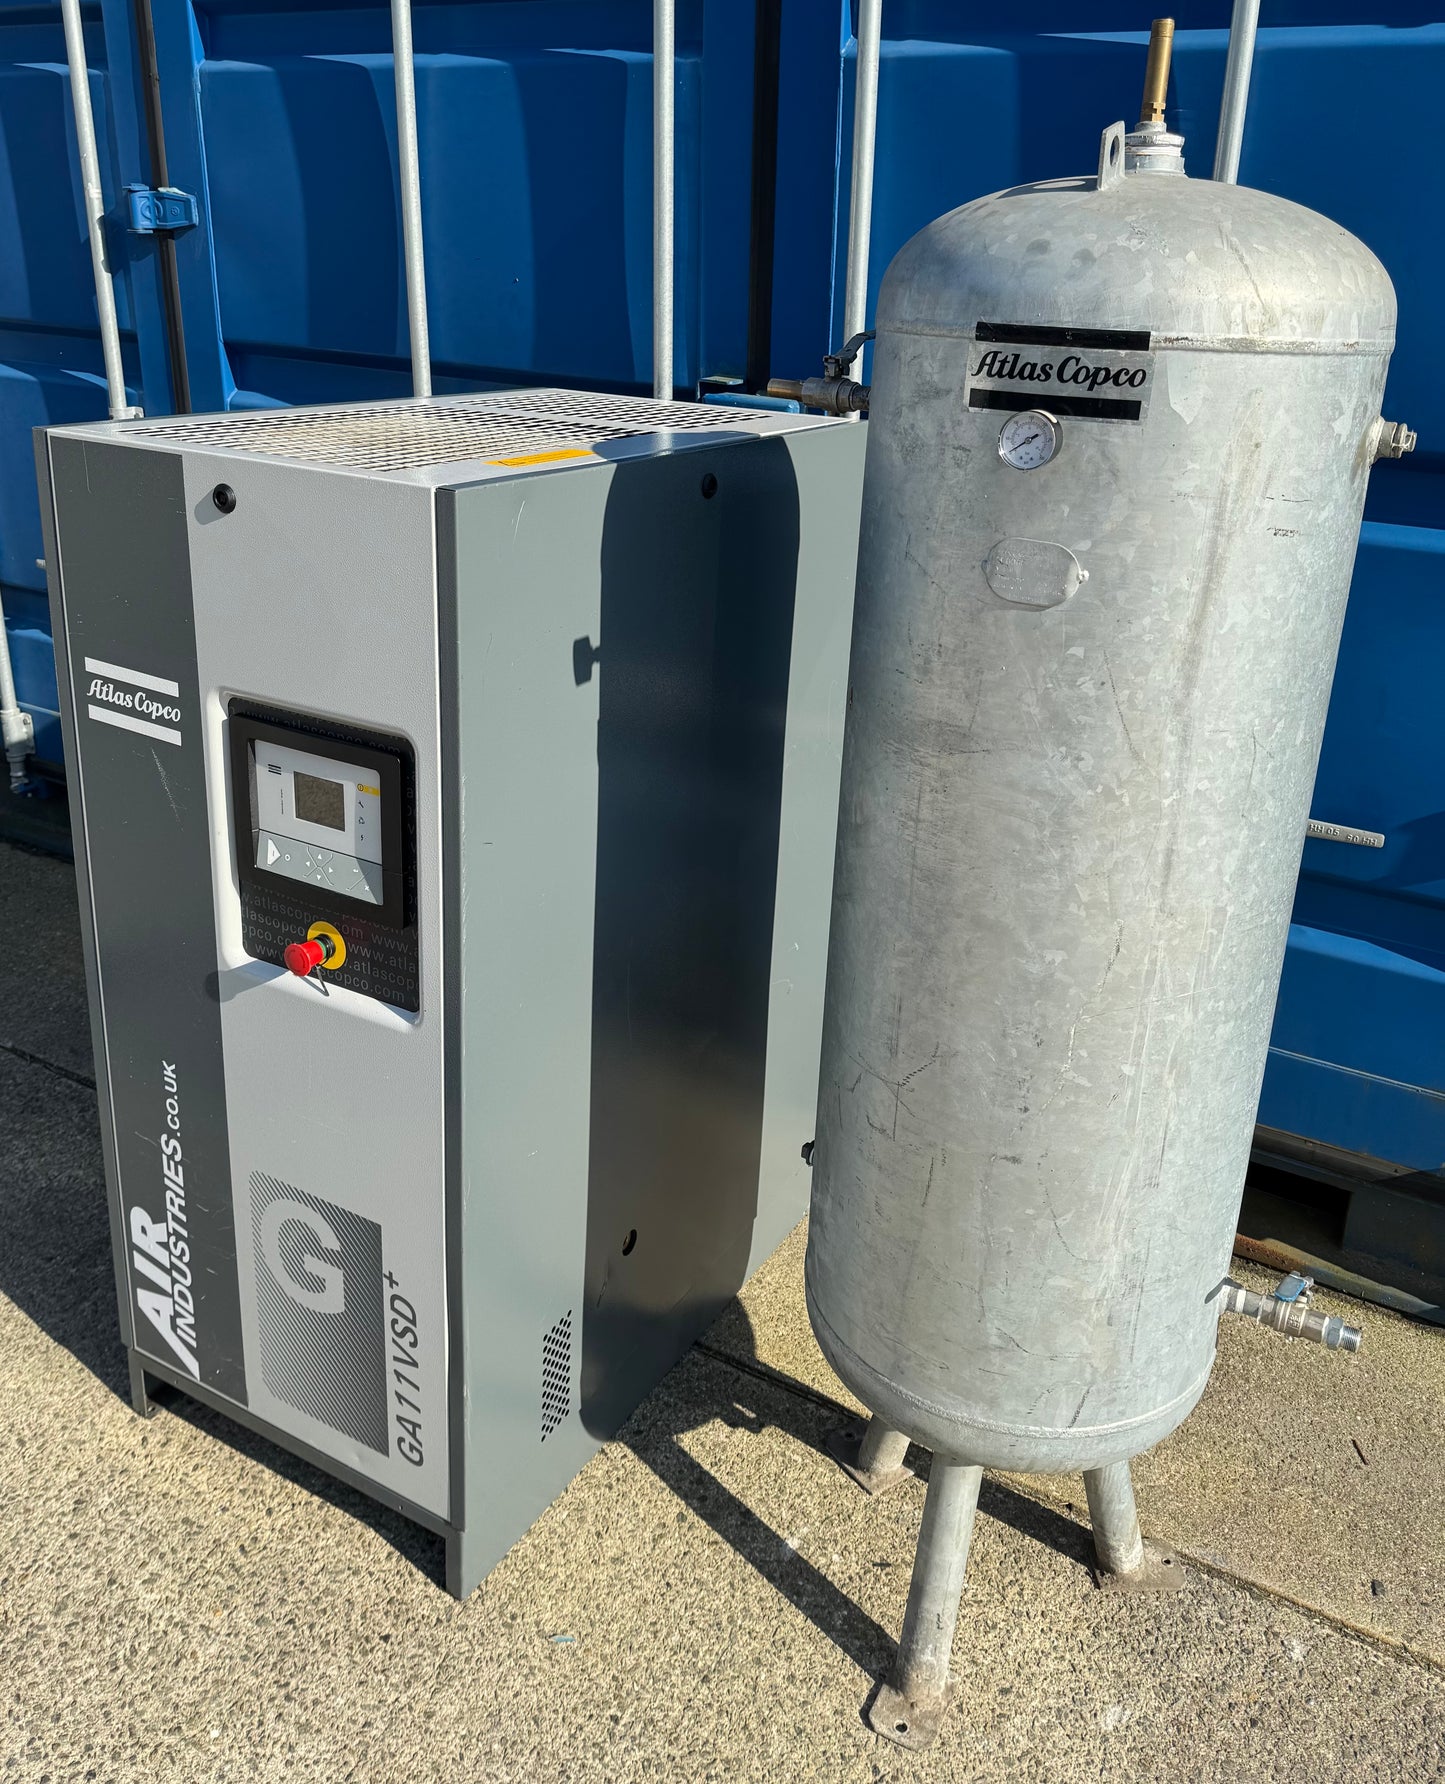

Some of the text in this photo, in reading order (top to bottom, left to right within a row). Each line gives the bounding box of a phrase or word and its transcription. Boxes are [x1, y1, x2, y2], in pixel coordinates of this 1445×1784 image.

[971, 351, 1147, 391] Atlas Copco
[86, 679, 181, 722] Atlas Copco
[129, 1206, 200, 1382] AIR
[260, 1199, 346, 1315] G
